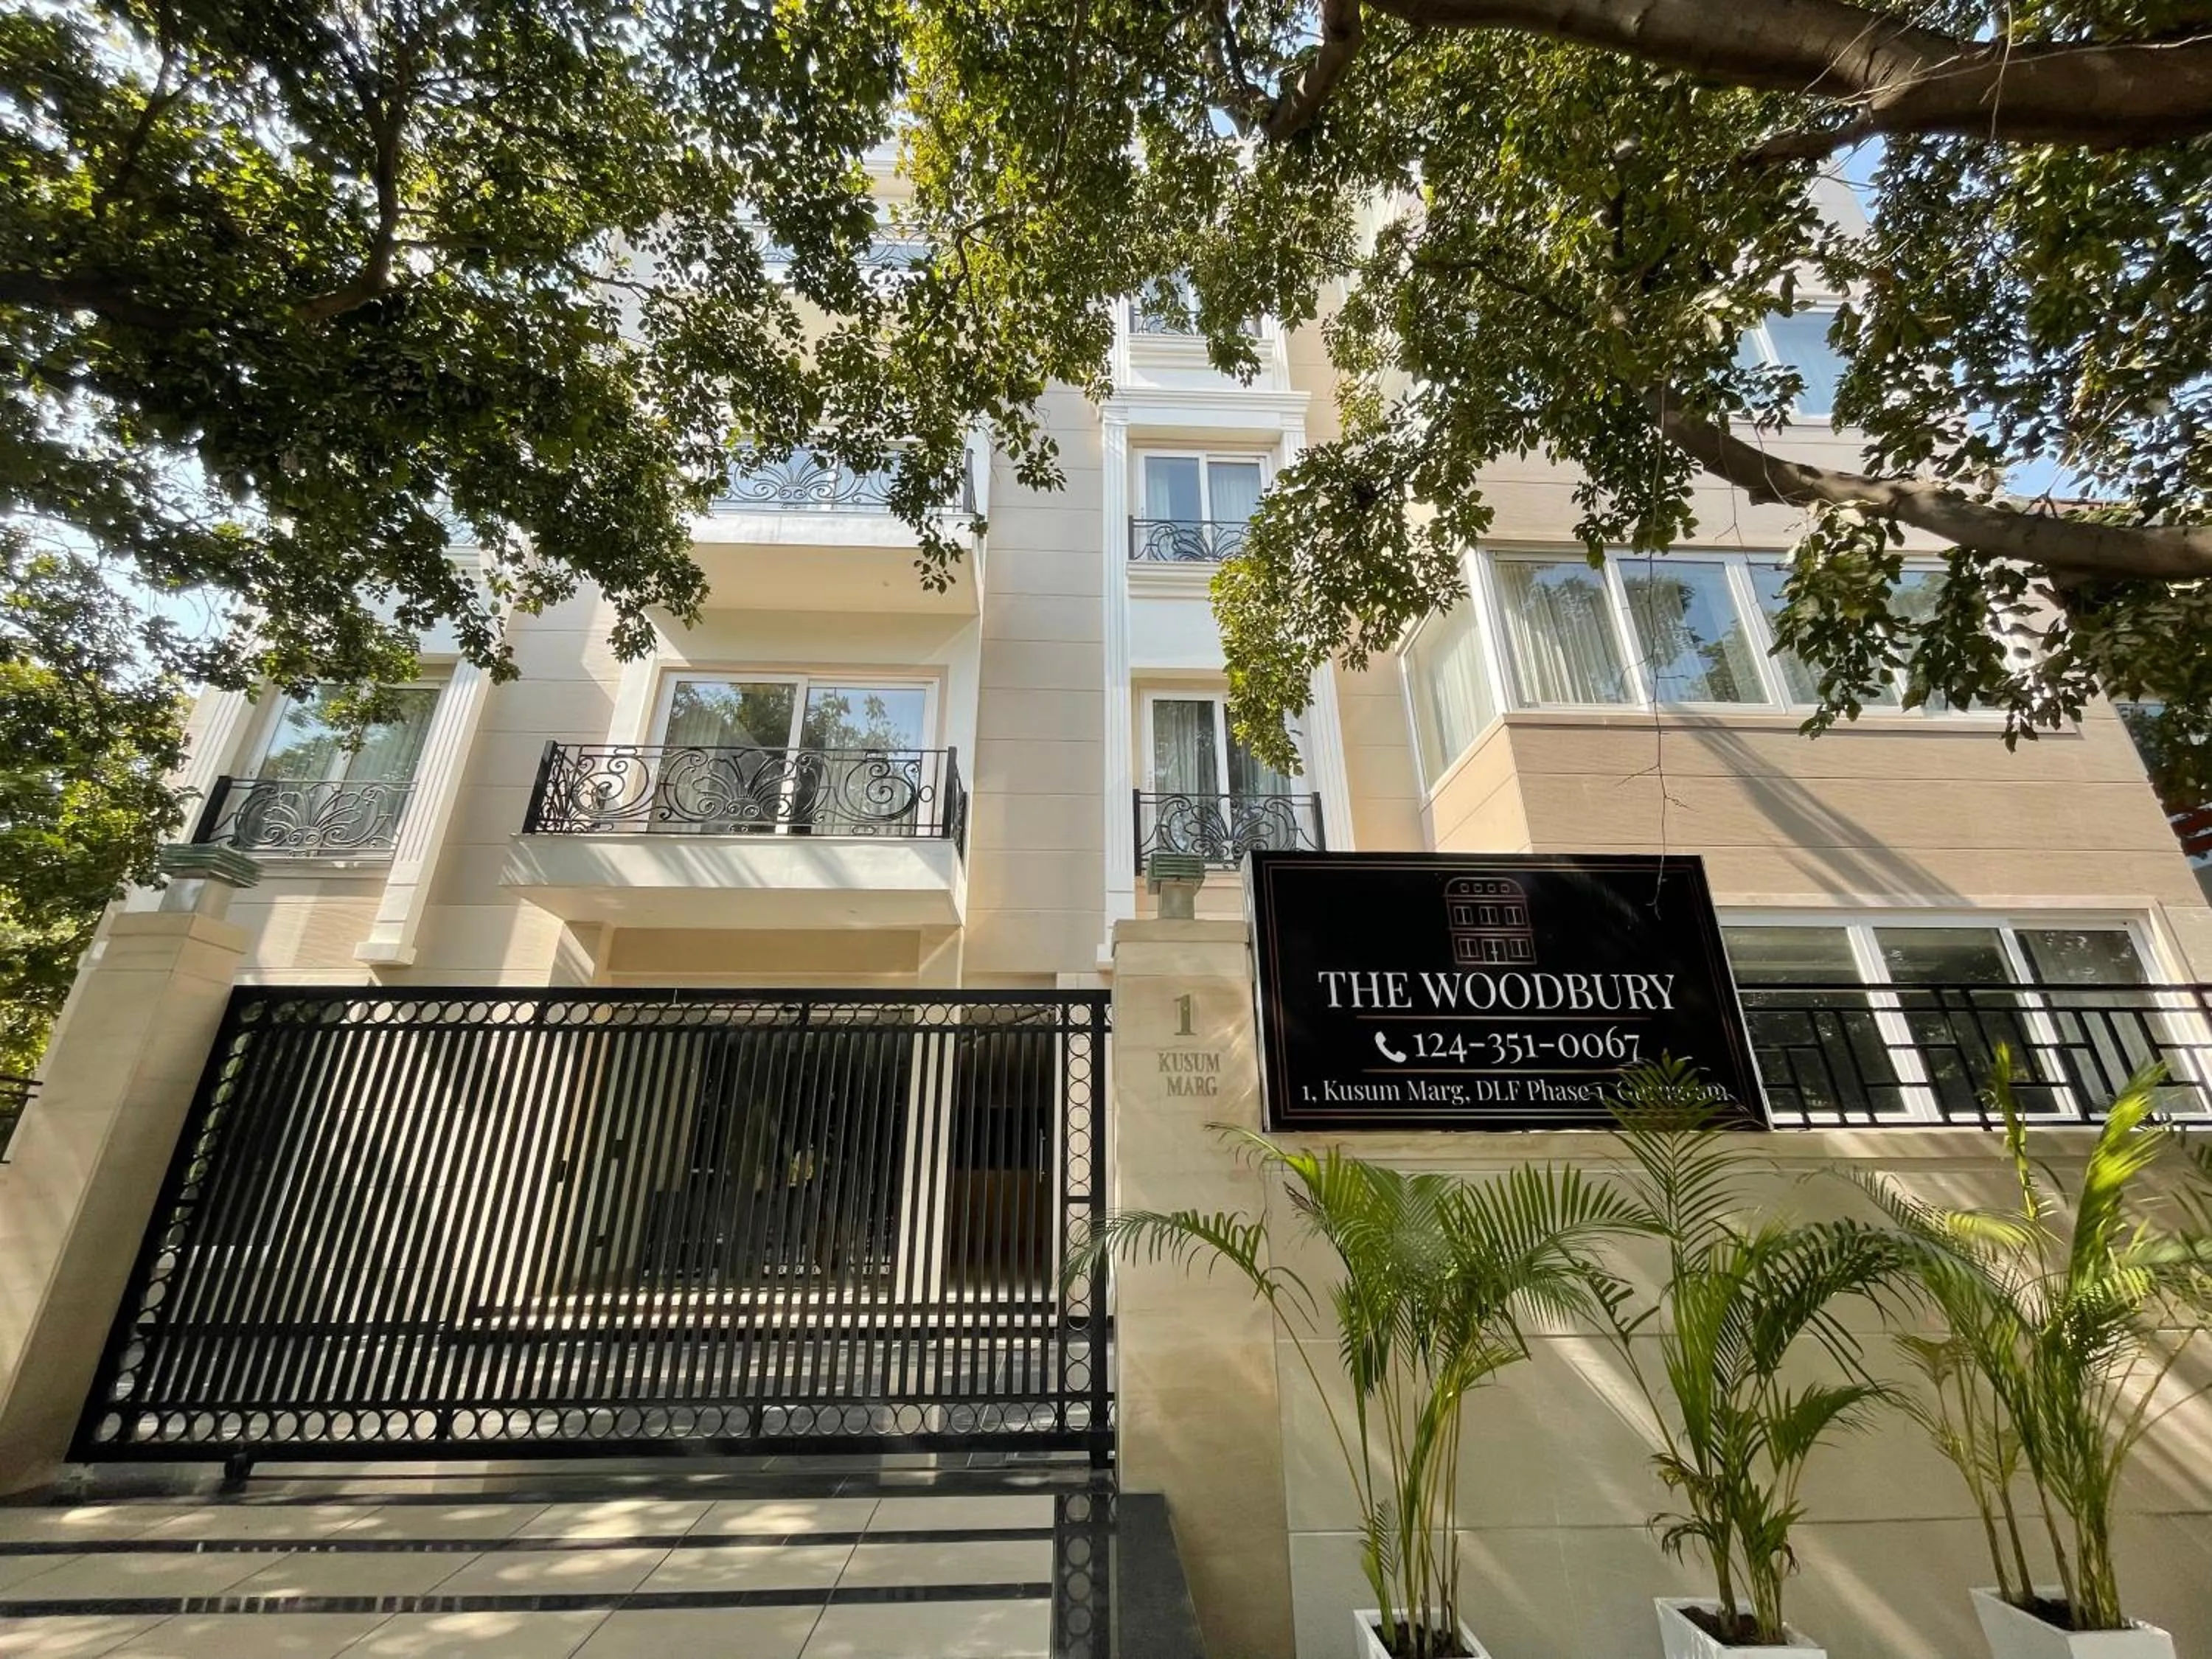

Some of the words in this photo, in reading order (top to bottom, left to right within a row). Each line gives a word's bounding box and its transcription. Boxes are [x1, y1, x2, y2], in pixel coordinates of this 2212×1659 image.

[1318, 971, 1412, 1009] THE
[1419, 972, 1675, 1010] WOODBURY
[1173, 994, 1198, 1036] 1
[1412, 1026, 1641, 1064] 124-351-0067
[1158, 1051, 1220, 1072] KUSUM
[1167, 1076, 1217, 1096] MARG
[1301, 1085, 1317, 1102] 1,
[1324, 1079, 1400, 1101] Kusum
[1407, 1080, 1470, 1105] Marg,
[1475, 1080, 1520, 1101] DLF
[1526, 1079, 1590, 1101] Phase
